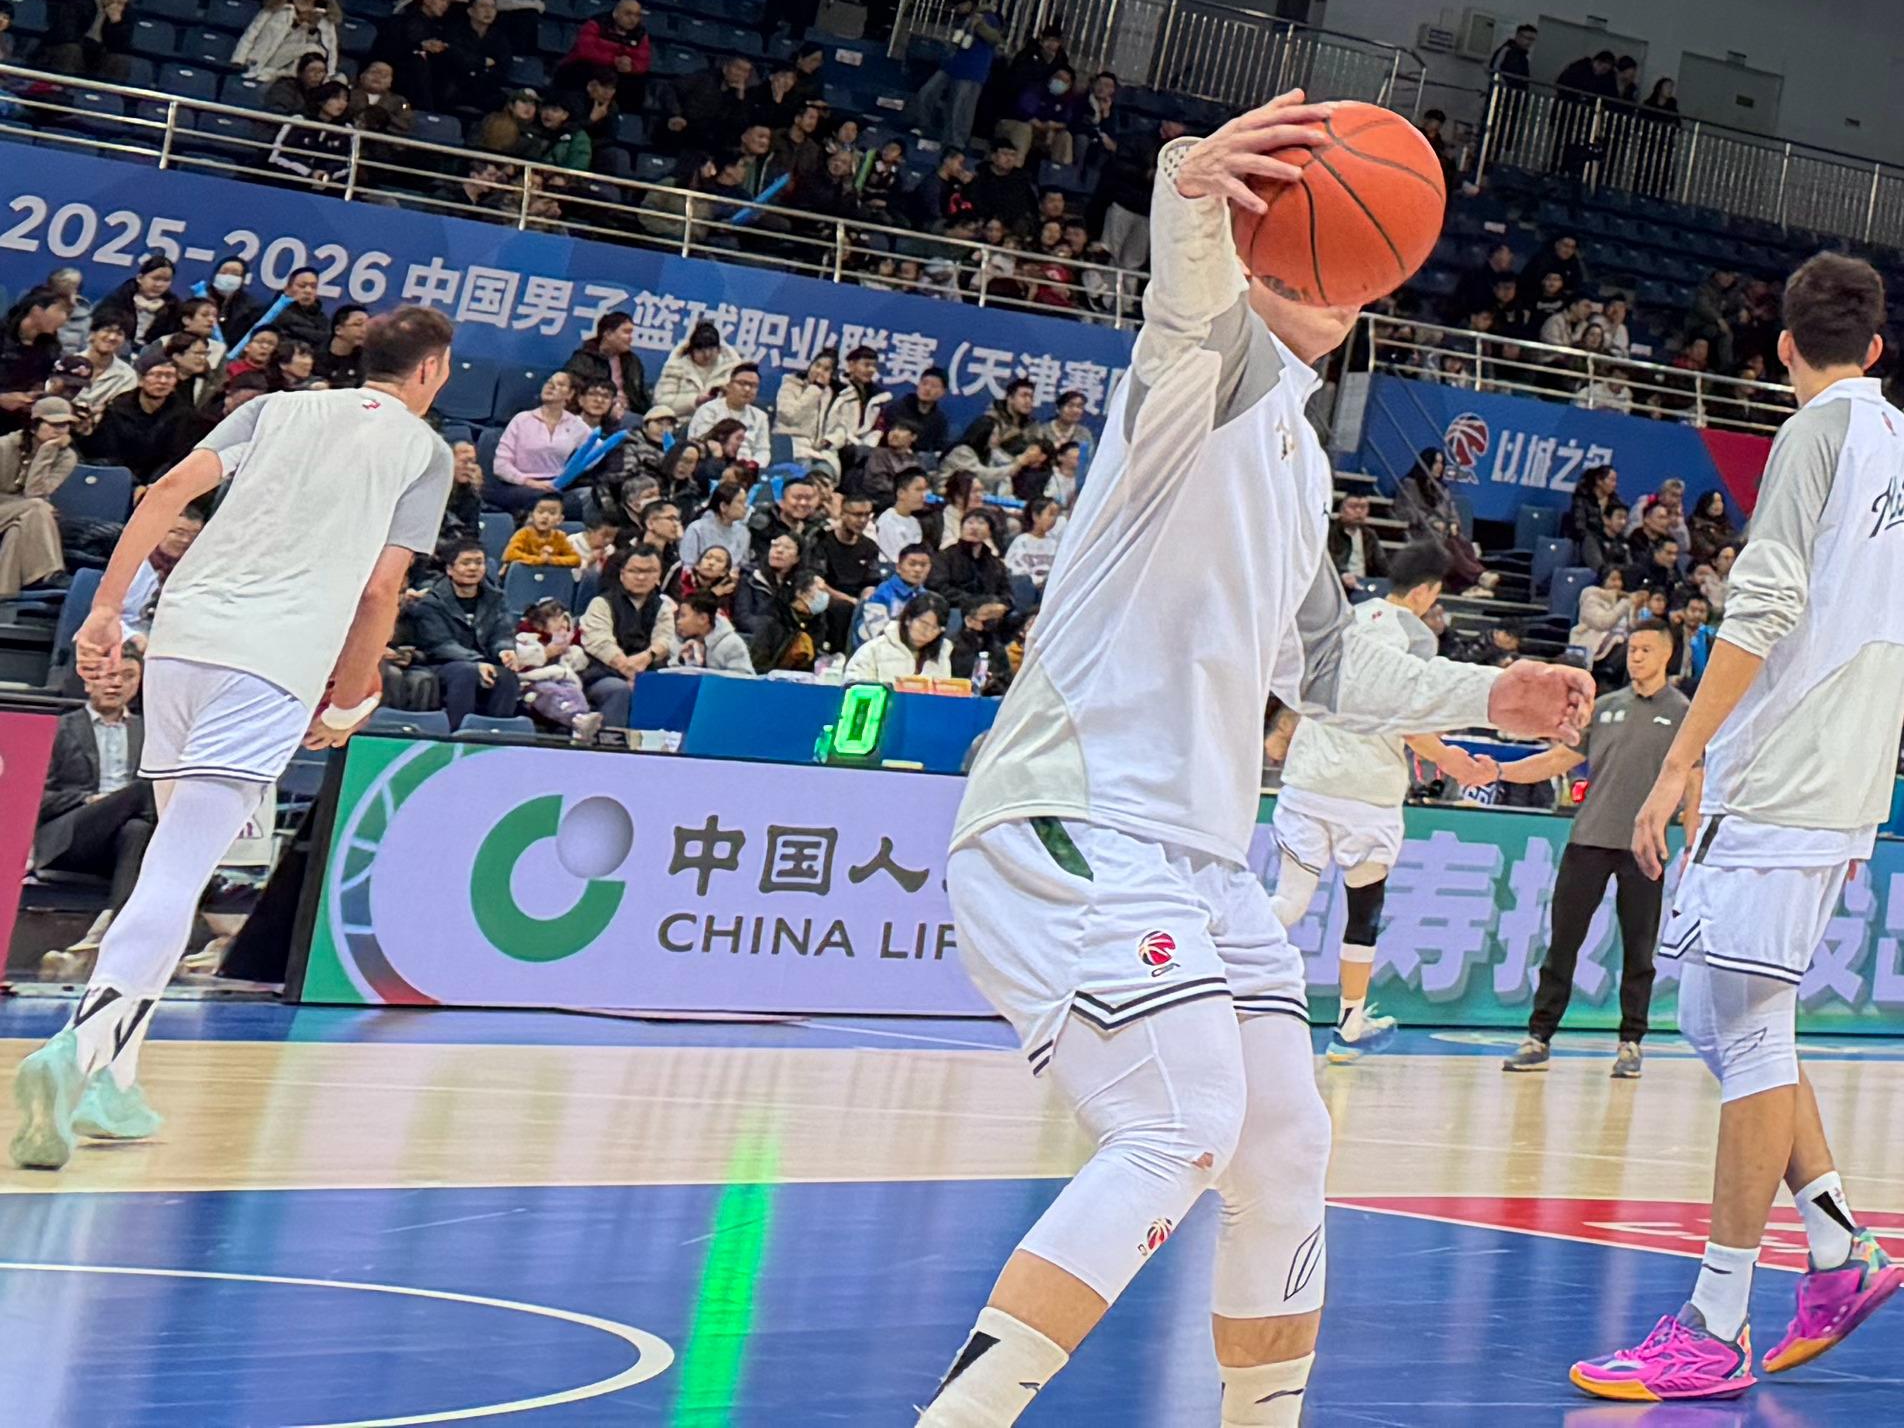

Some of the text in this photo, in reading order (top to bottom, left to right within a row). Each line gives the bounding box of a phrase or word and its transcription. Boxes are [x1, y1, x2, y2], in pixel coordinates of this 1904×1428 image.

[834, 685, 887, 756] 0
[669, 815, 948, 896] 中国人
[658, 913, 957, 960] CHINA LIF
